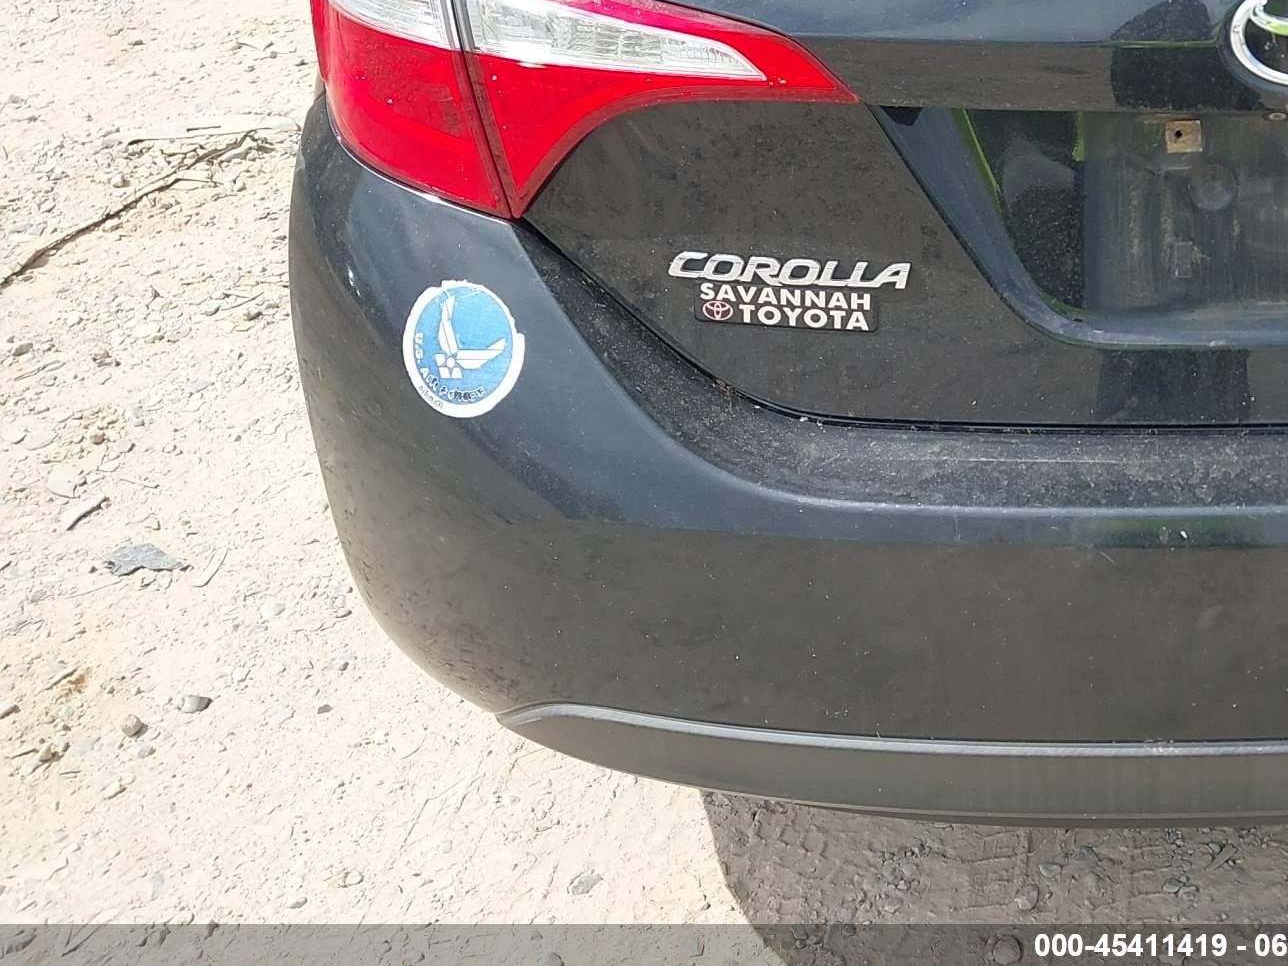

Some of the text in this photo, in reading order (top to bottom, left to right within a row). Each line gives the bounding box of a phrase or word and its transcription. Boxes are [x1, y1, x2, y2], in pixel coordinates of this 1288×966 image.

[668, 251, 911, 289] COROLLA
[700, 283, 871, 310] SAVANNAH
[739, 304, 869, 331] TOYOTA
